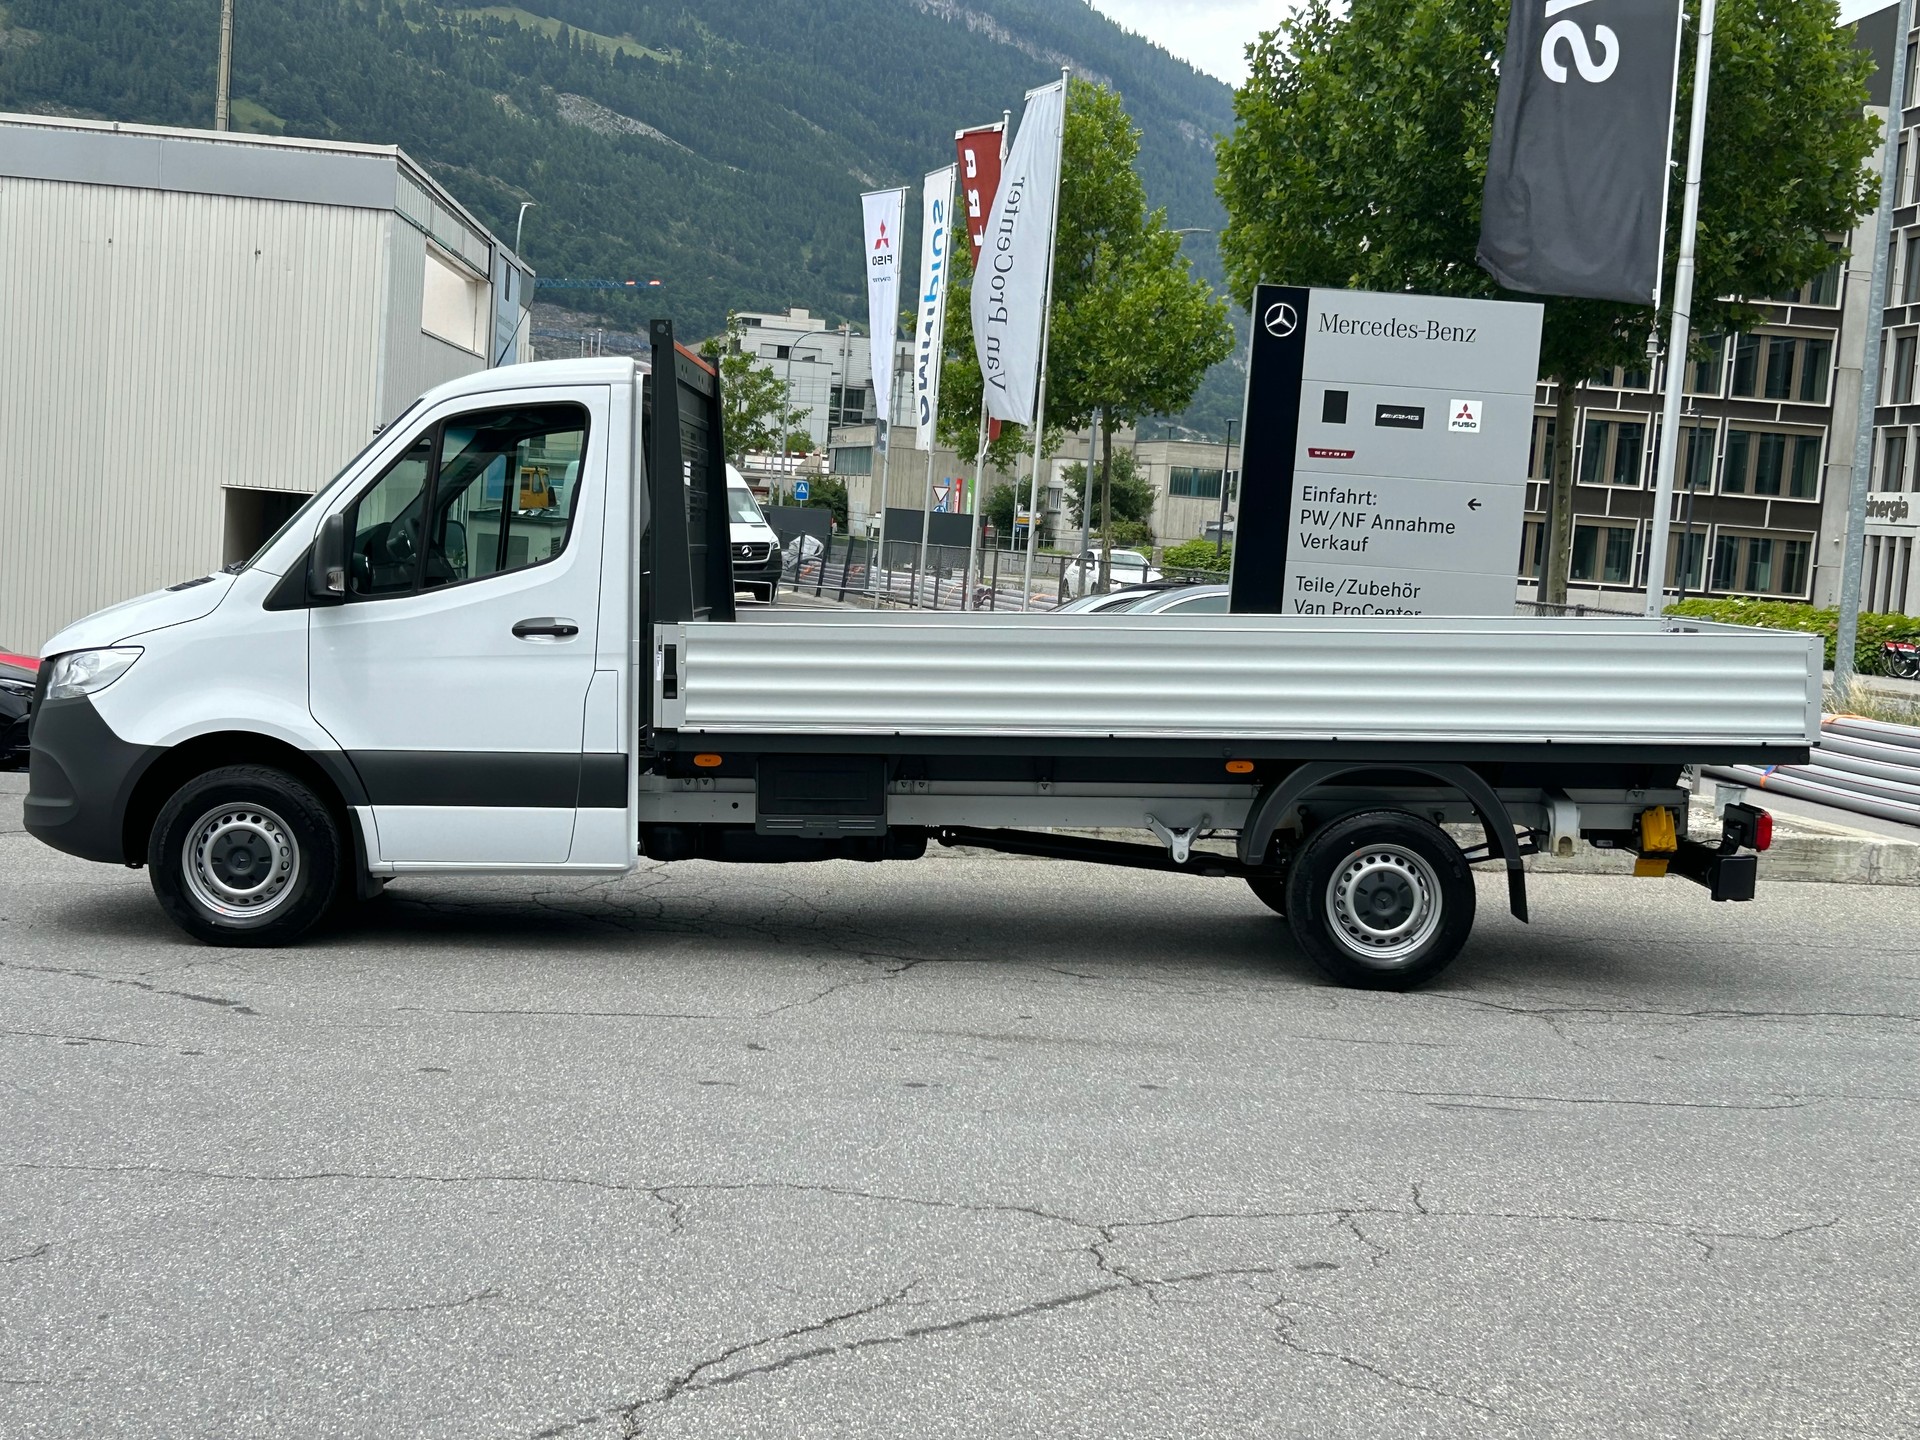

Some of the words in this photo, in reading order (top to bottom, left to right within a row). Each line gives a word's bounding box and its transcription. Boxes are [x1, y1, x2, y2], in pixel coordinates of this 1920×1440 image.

[1318, 312, 1477, 343] Mercedes-Benz
[1451, 420, 1477, 429] FUSO
[1302, 486, 1378, 506] Einfahrt:
[1300, 509, 1367, 530] PW/NF
[1371, 514, 1455, 534] Annahme
[1300, 533, 1369, 552] Verkauf
[1295, 575, 1421, 598] Teile/Zubehör
[1294, 599, 1325, 614] Van
